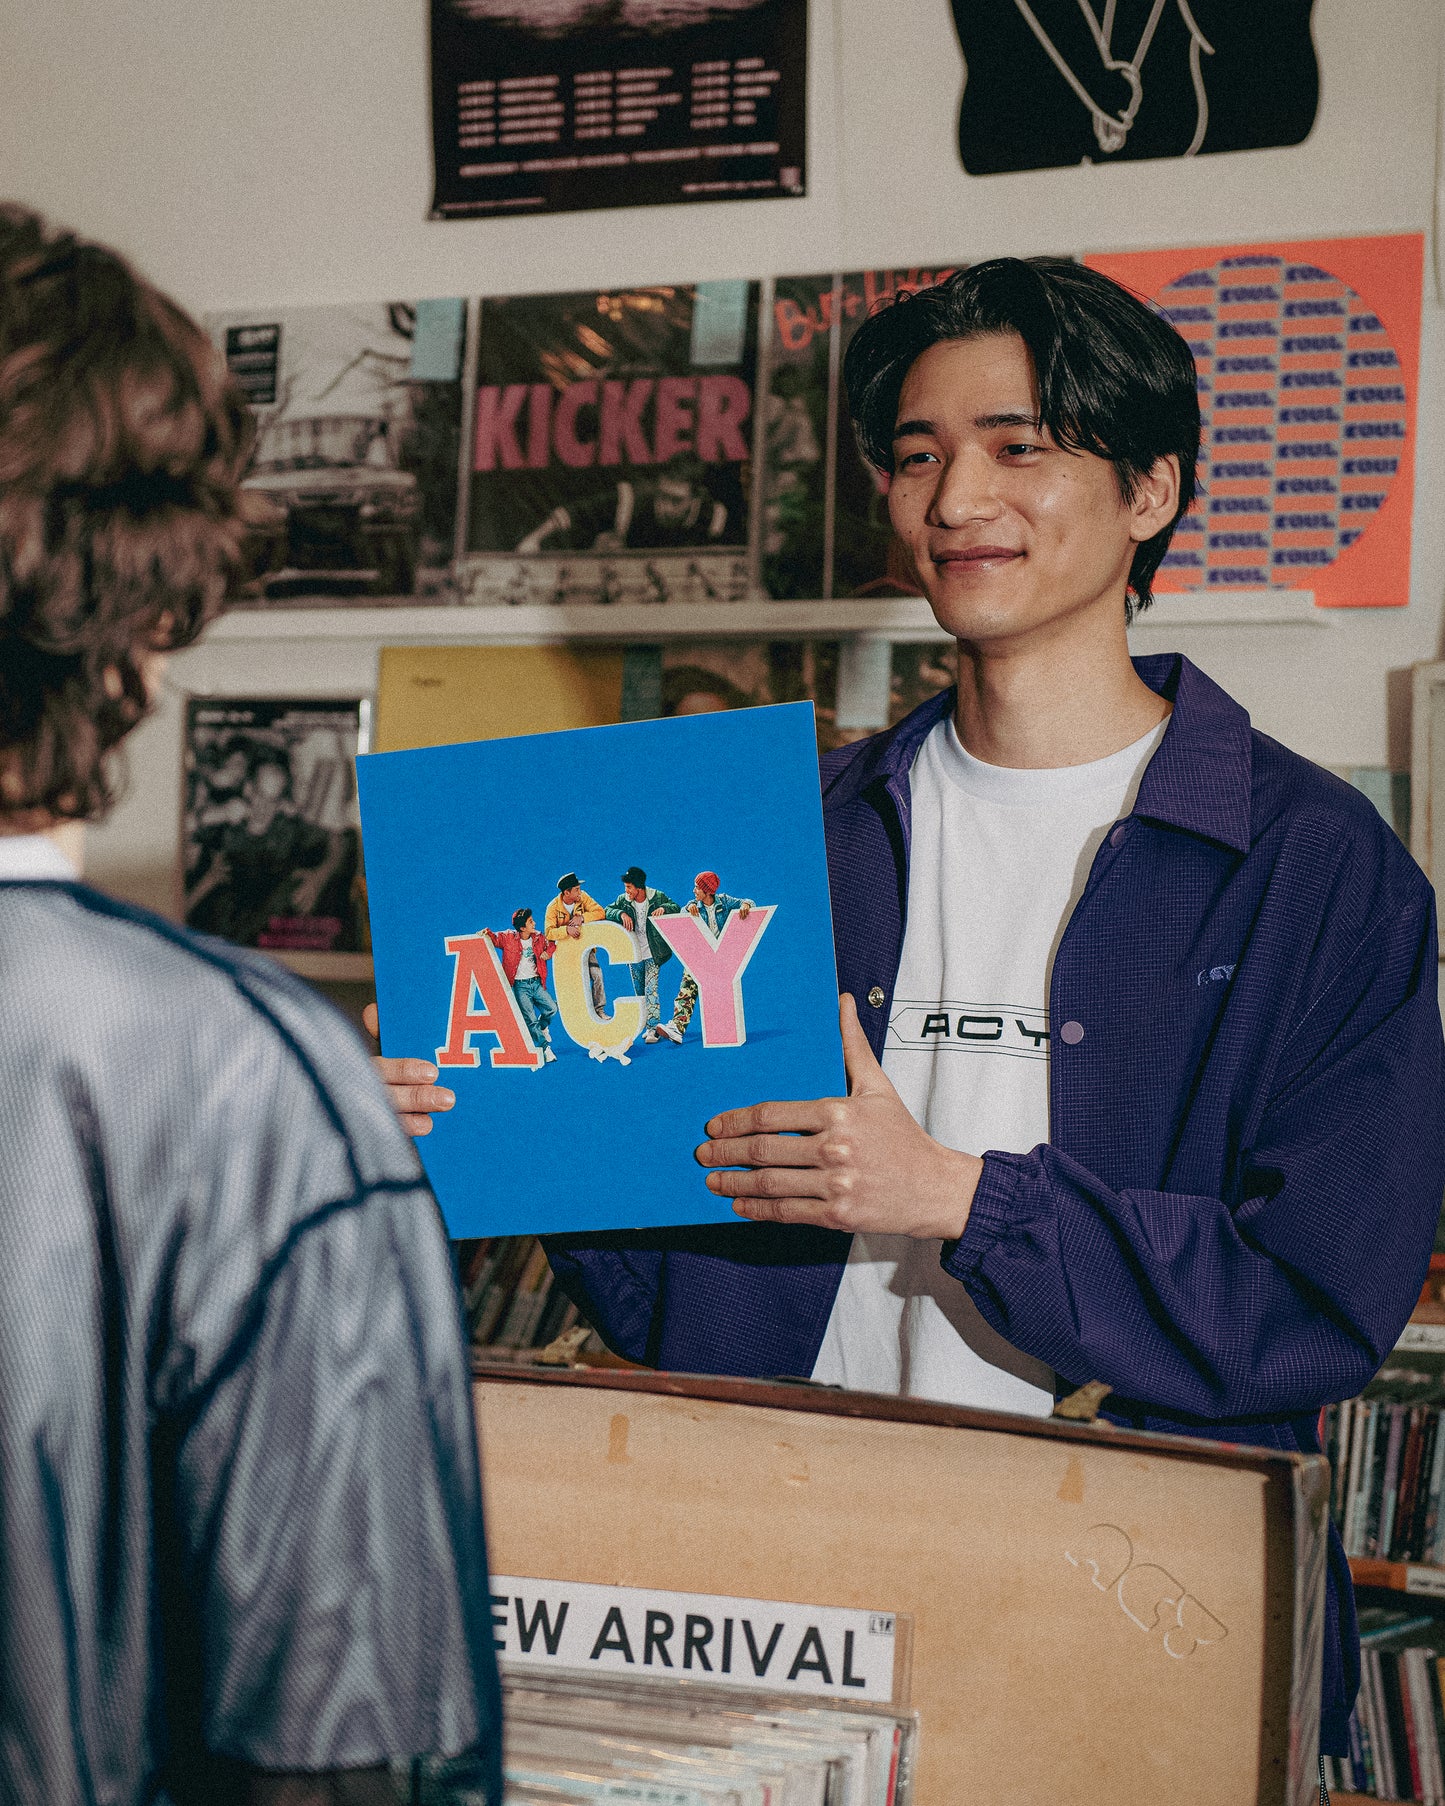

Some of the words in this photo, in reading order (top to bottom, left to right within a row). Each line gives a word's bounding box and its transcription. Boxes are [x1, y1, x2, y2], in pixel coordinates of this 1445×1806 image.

[474, 375, 752, 472] KICKER
[435, 904, 779, 1069] ACY
[589, 1604, 866, 1688] ARRIVAL
